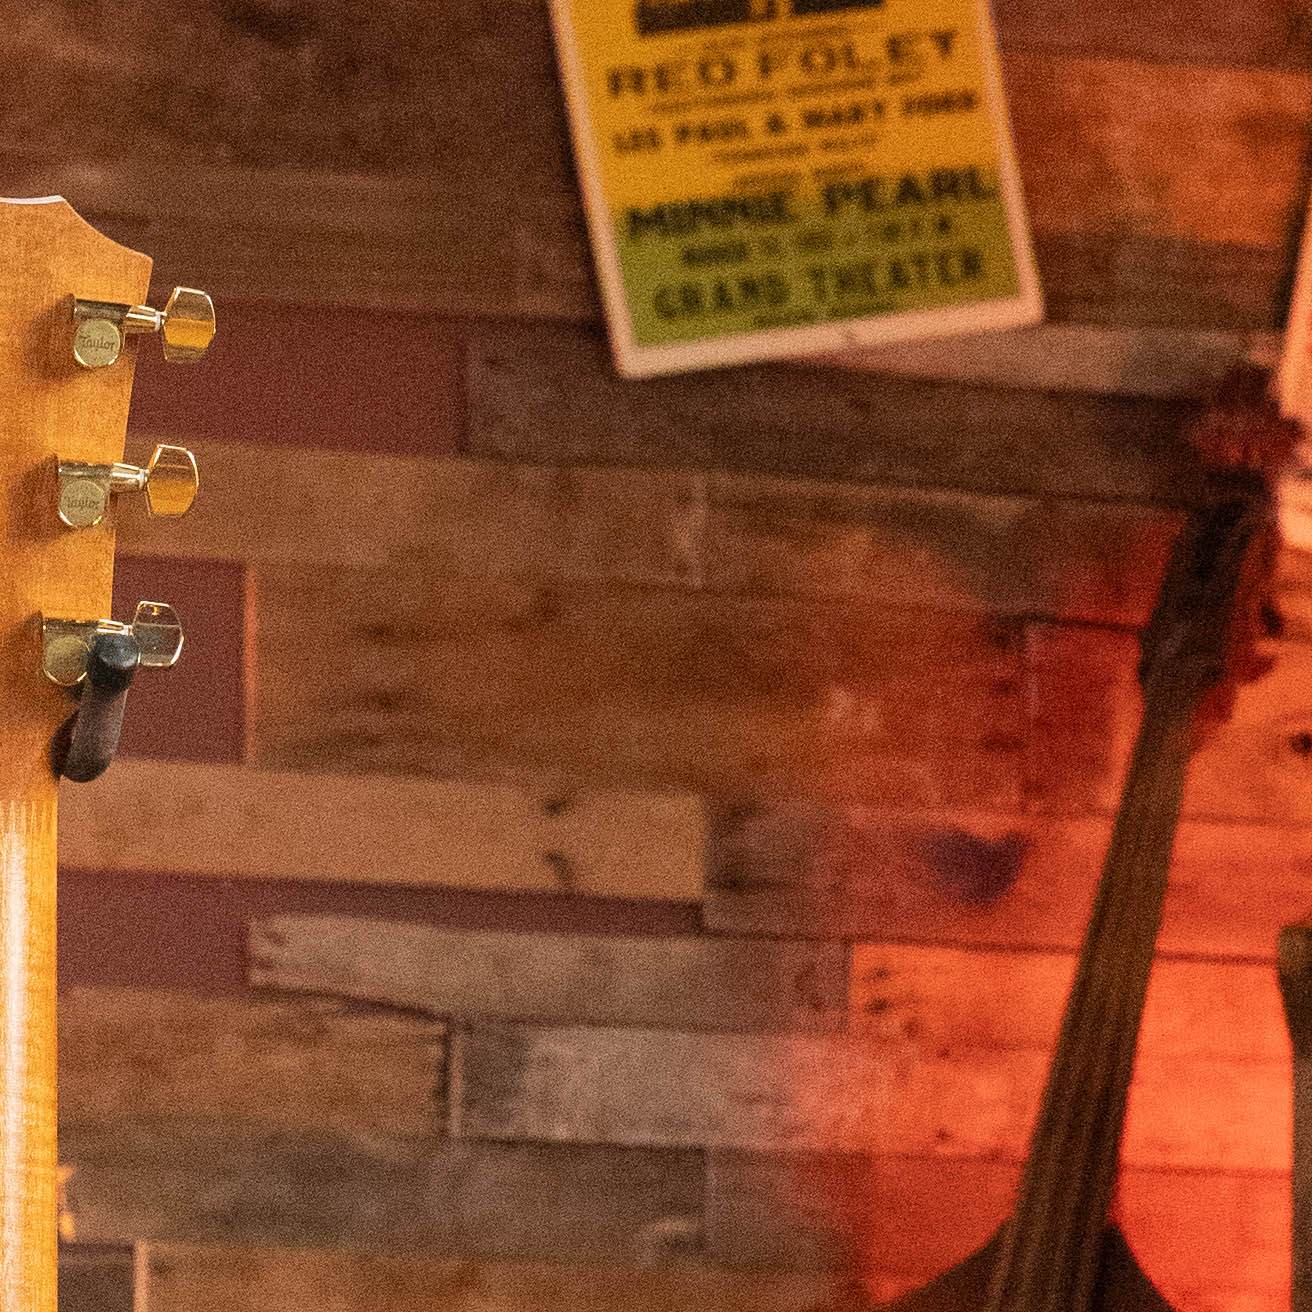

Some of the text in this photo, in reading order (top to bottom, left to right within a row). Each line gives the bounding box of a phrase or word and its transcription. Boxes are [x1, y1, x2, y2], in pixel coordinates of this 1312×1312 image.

[759, 30, 957, 79] FOLEY
[822, 168, 998, 215] PEARL
[79, 336, 115, 353] Taylor
[64, 495, 100, 511] Taylor
